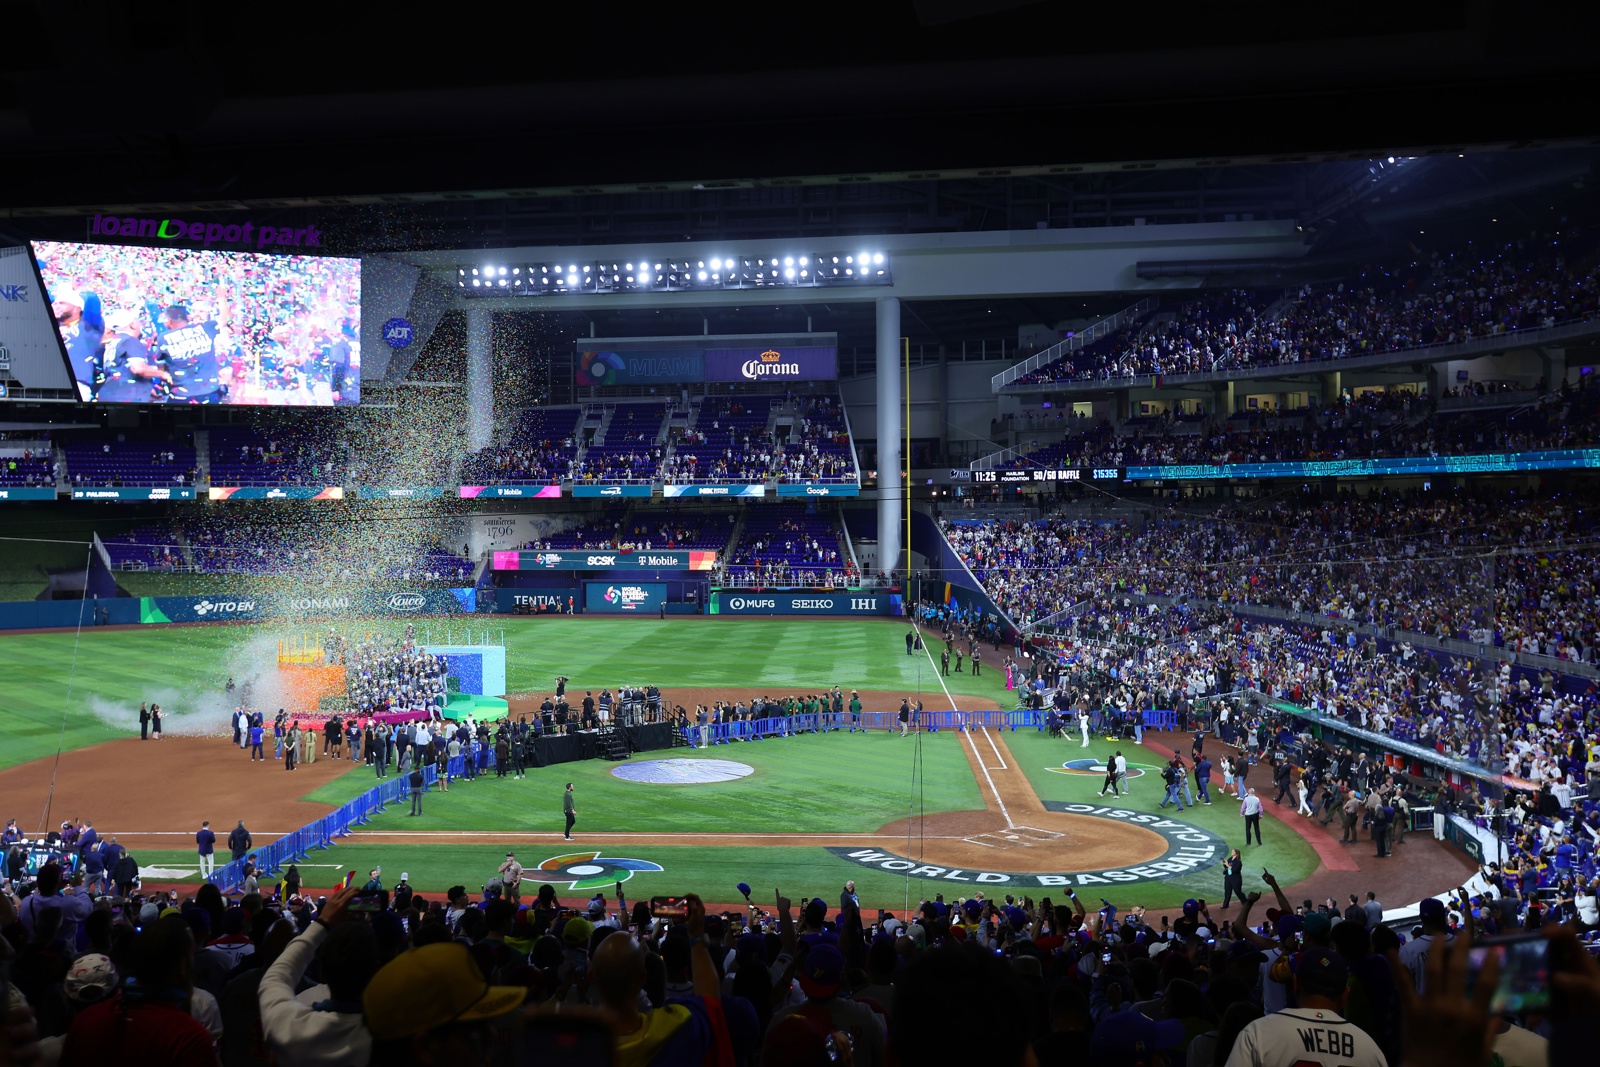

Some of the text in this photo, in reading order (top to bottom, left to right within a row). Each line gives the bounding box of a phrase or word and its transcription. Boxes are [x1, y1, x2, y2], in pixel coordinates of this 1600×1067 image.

[92, 214, 321, 249] loanDepot park
[386, 327, 411, 339] ADT
[629, 357, 699, 377] MIAMI
[741, 359, 800, 380] Corona
[1302, 460, 1375, 476] VENEZUELA
[1444, 454, 1518, 472] VENEZUELA
[974, 471, 997, 482] 11:25
[1033, 469, 1080, 481] 50/50 RAFFLE
[1093, 468, 1119, 480] $15355
[1158, 464, 1233, 479] VENEZUELA
[806, 486, 829, 496] Google
[487, 526, 513, 540] 1796
[587, 555, 615, 566] SCSK
[648, 555, 678, 566] Mobile
[291, 598, 350, 610] KONAMI
[388, 595, 425, 607] Kowa
[746, 599, 775, 608] MUFG
[792, 599, 834, 609] SEIKO
[850, 598, 877, 610] IHI
[213, 602, 255, 613] ITO EN
[845, 804, 1215, 886] WORLD BASEBALL CLASSIC
[1297, 1028, 1354, 1058] WEBB
